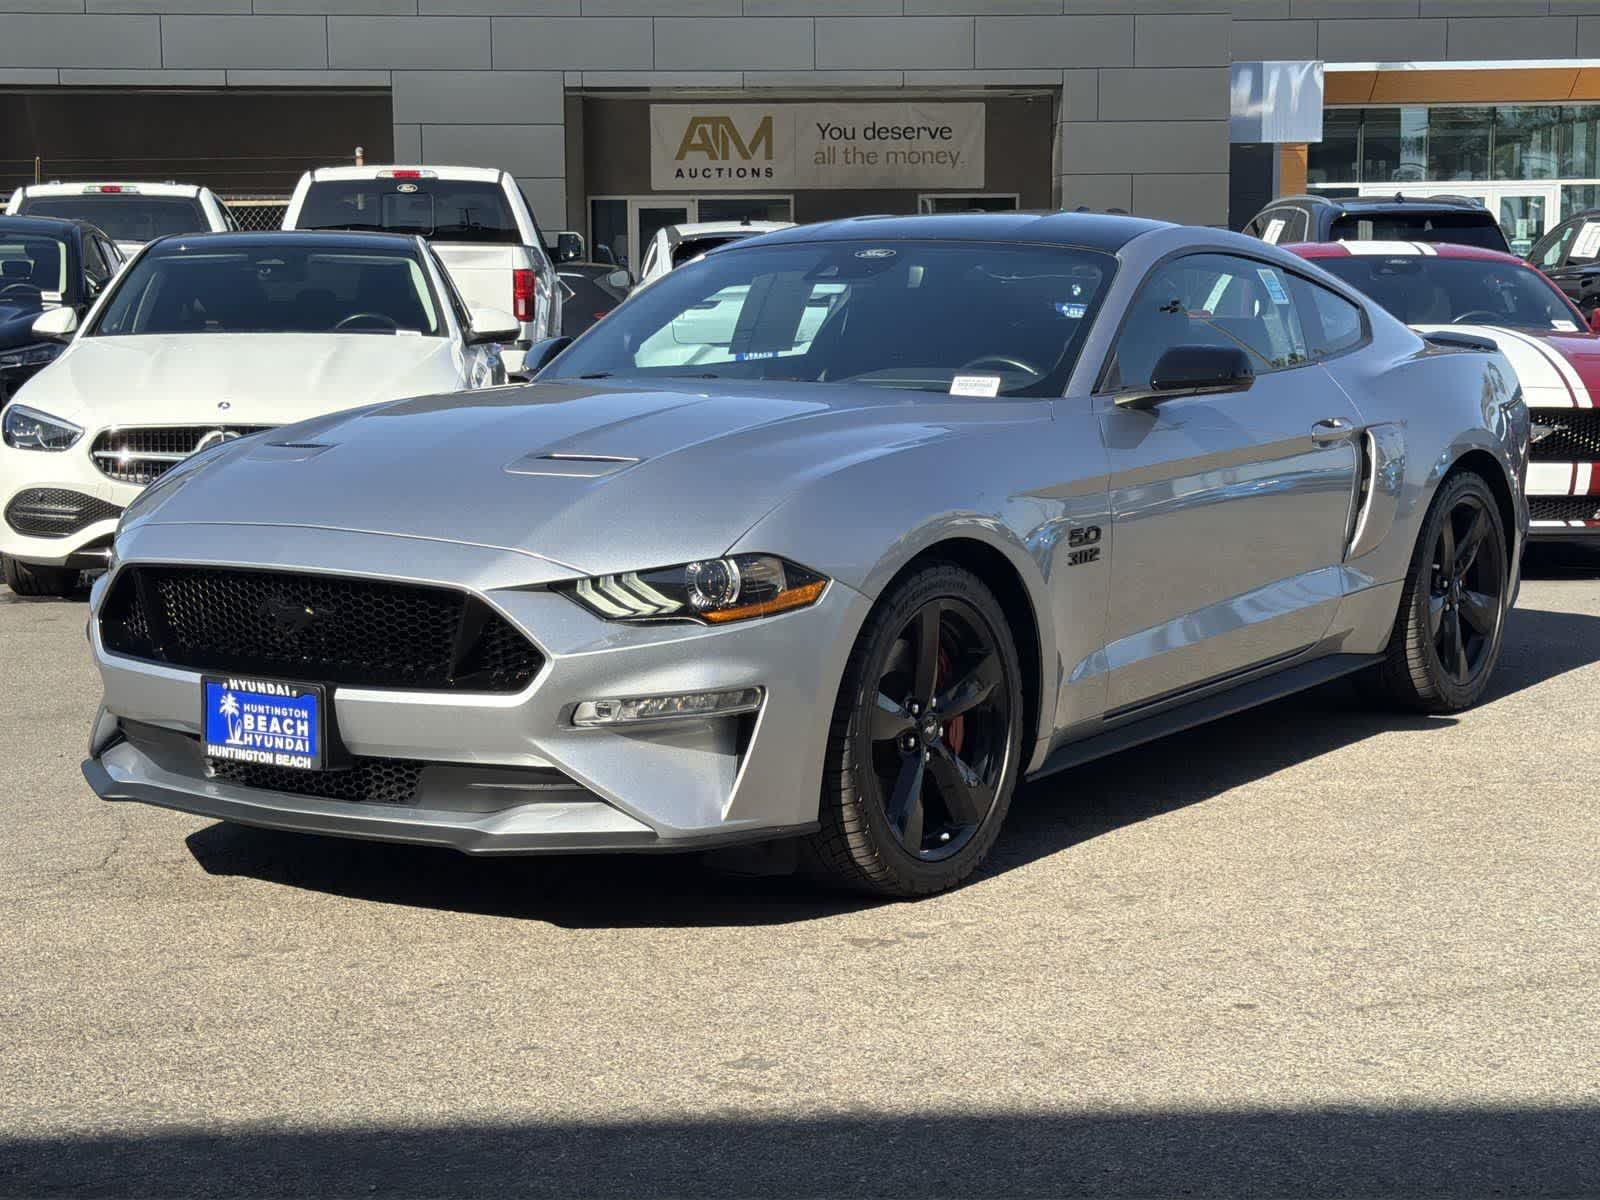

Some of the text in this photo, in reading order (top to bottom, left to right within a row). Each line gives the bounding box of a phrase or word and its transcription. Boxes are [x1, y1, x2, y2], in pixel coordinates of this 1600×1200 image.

[675, 116, 773, 160] ATM
[816, 121, 953, 141] You deserve
[814, 146, 965, 168] all the money.
[675, 167, 774, 179] AUCTIONS
[1068, 548, 1100, 566] 302
[229, 679, 290, 696] HYUNDAI
[243, 703, 308, 718] HUNTINGTON
[243, 714, 309, 737] BEACH
[243, 733, 309, 752] HYUNDAI
[207, 744, 311, 769] HUNTINGTON BEACH
